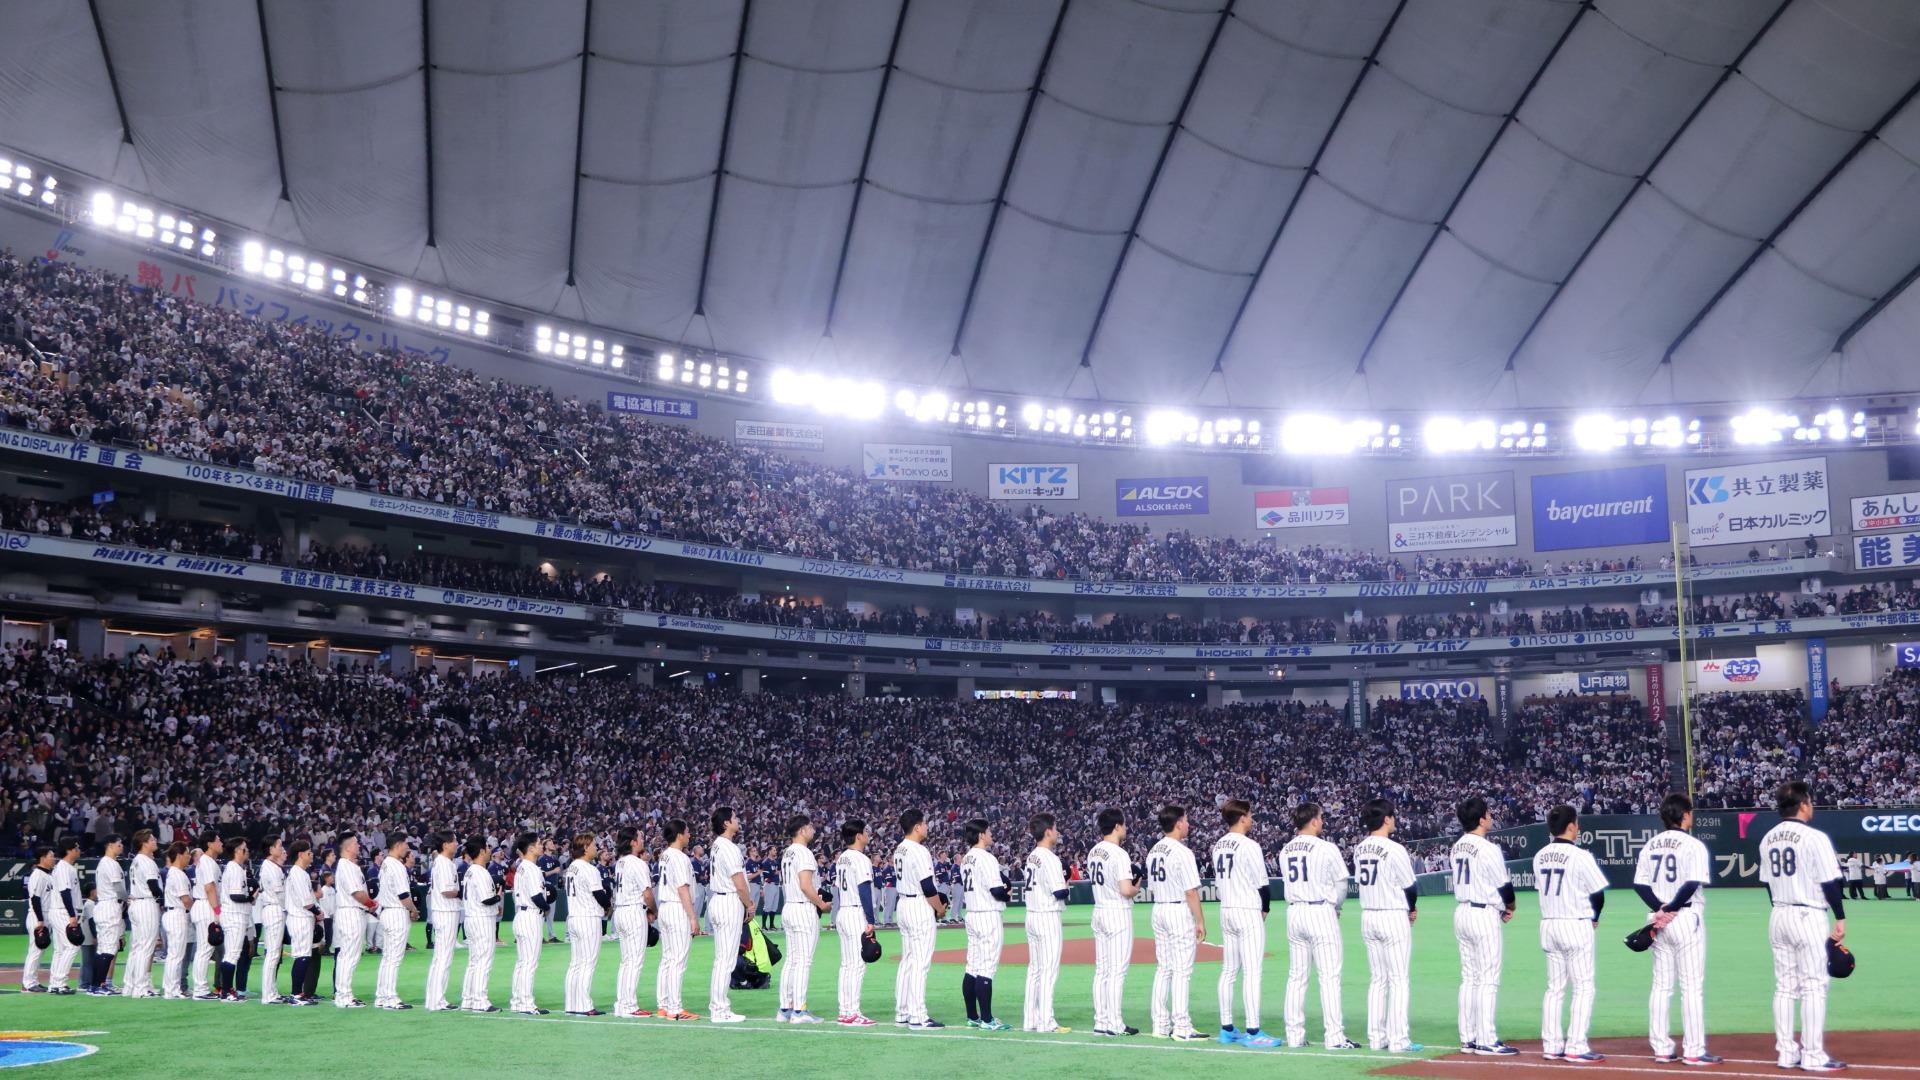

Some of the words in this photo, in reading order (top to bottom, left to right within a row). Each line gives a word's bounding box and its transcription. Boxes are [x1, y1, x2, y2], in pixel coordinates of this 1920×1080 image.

[613, 395, 692, 416] 電協通信工業
[21, 437, 67, 455] DISPLAY
[70, 442, 143, 471] 作画会
[185, 464, 285, 492] 100年をつくる会社
[901, 468, 929, 477] TOKYO
[931, 469, 949, 478] GAS
[999, 467, 1068, 485] KITZ
[1732, 470, 1824, 497] 共立製薬
[1138, 486, 1204, 500] ALSOK
[1399, 480, 1501, 517] PARK
[1287, 509, 1346, 523] 品川リフラ
[1547, 496, 1653, 524] baycurrent
[1729, 510, 1827, 532] 日本カルミック
[280, 569, 416, 600] 電協通信工業株式会社
[1074, 582, 1178, 597] 日本ステージ株式会社
[1529, 578, 1555, 590] APA
[1558, 573, 1644, 588] コーポレーション
[1697, 619, 1793, 638] 第一工業
[1203, 649, 1252, 657] HOCHIKI
[1403, 682, 1476, 700] TOTO
[1581, 672, 1628, 690] JR貨物
[1696, 818, 1721, 827] 329ft
[1284, 841, 1315, 855] SUZUKI
[1650, 838, 1682, 851] KAMEI
[1767, 830, 1801, 846] KANEKO
[1150, 857, 1166, 882] 46
[1217, 854, 1234, 879] 47
[1287, 856, 1308, 883] 51
[1539, 852, 1569, 866] SOYOGI
[1650, 854, 1677, 883] 79
[1769, 847, 1797, 877] 88
[1090, 861, 1105, 886] 26
[1359, 859, 1379, 886] 57
[1455, 858, 1470, 885] 71
[1540, 868, 1565, 896] 77
